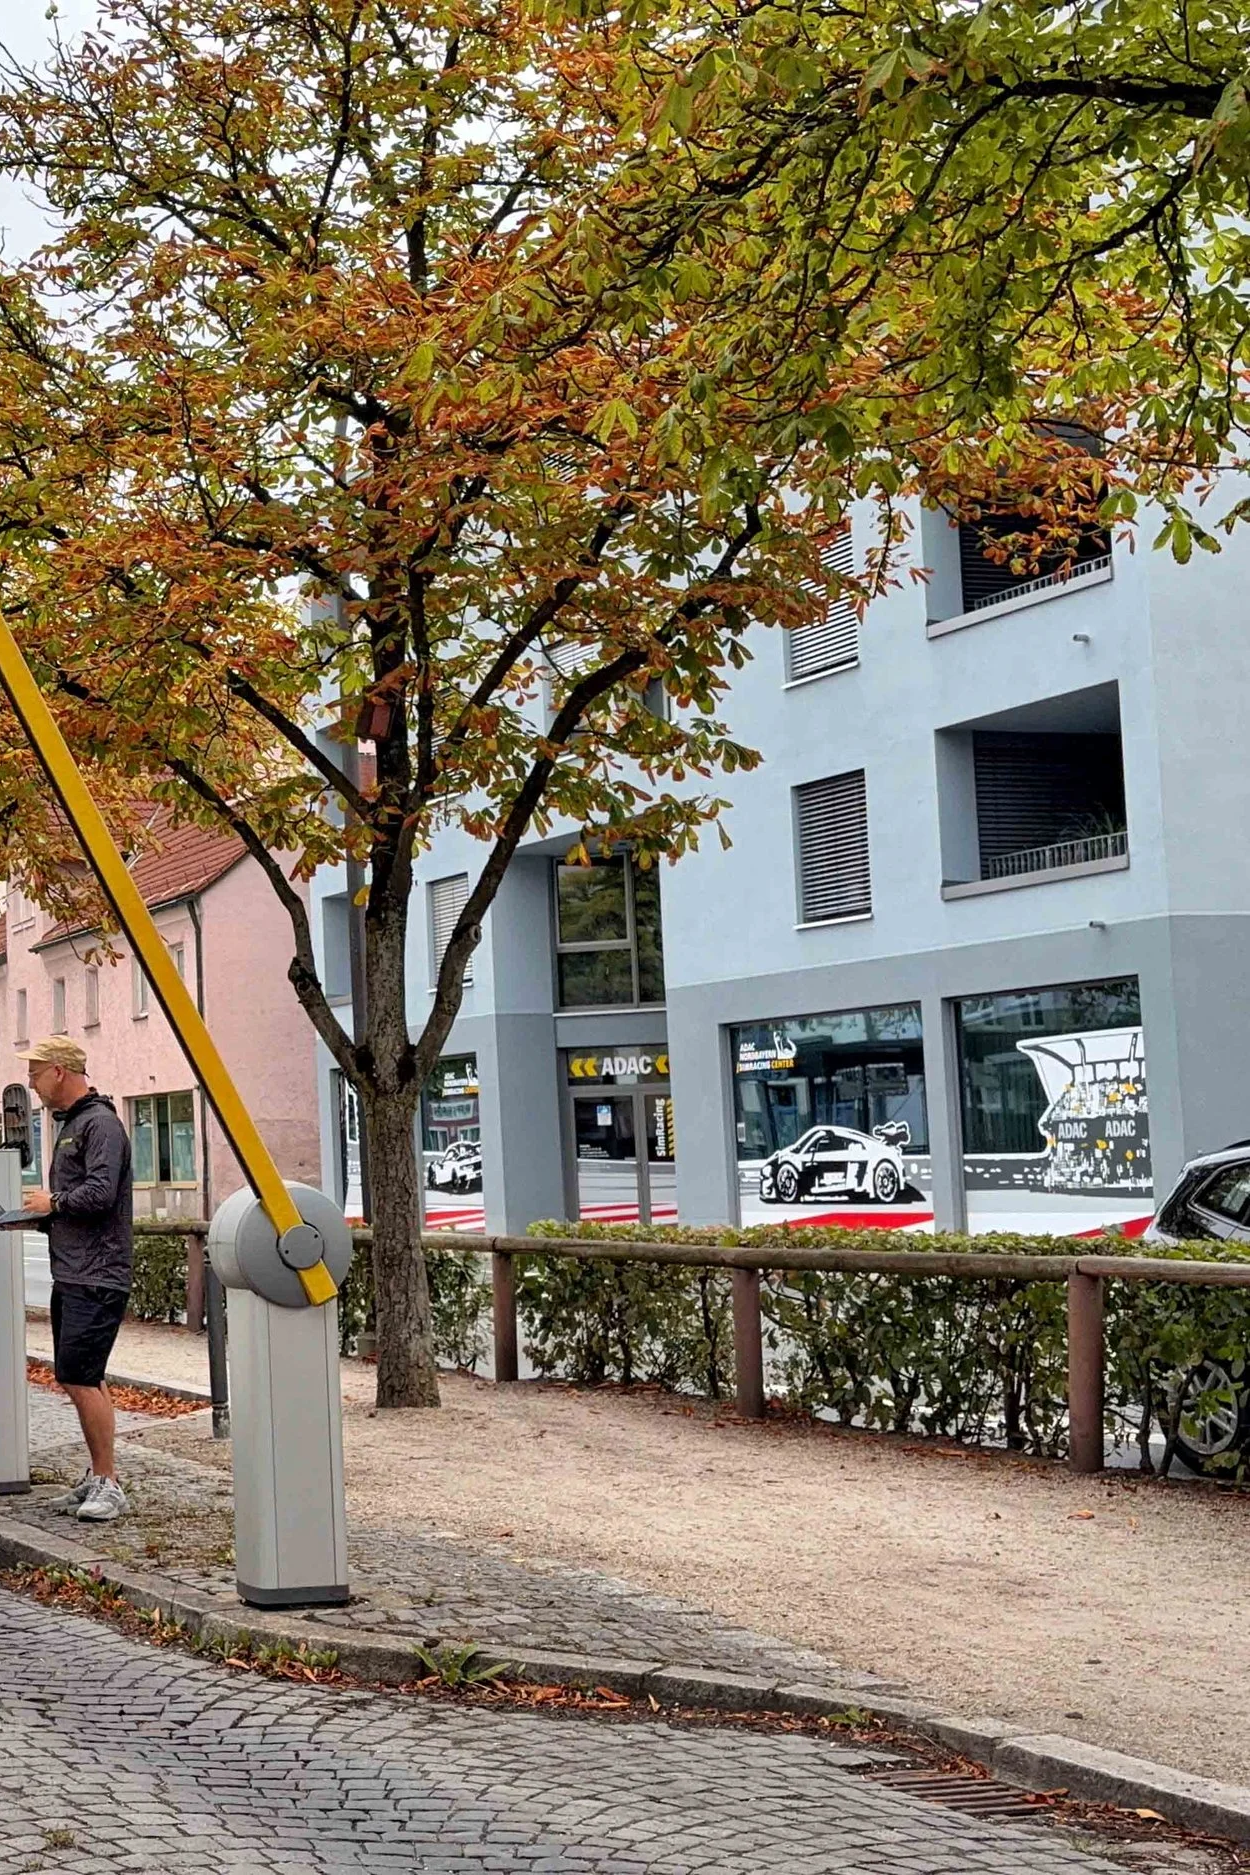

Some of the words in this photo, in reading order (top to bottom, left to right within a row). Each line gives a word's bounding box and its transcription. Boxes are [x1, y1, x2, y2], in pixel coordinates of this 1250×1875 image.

[601, 1056, 652, 1076] ADAC
[1058, 1122, 1087, 1139] ADAC
[1105, 1119, 1136, 1137] ADAC
